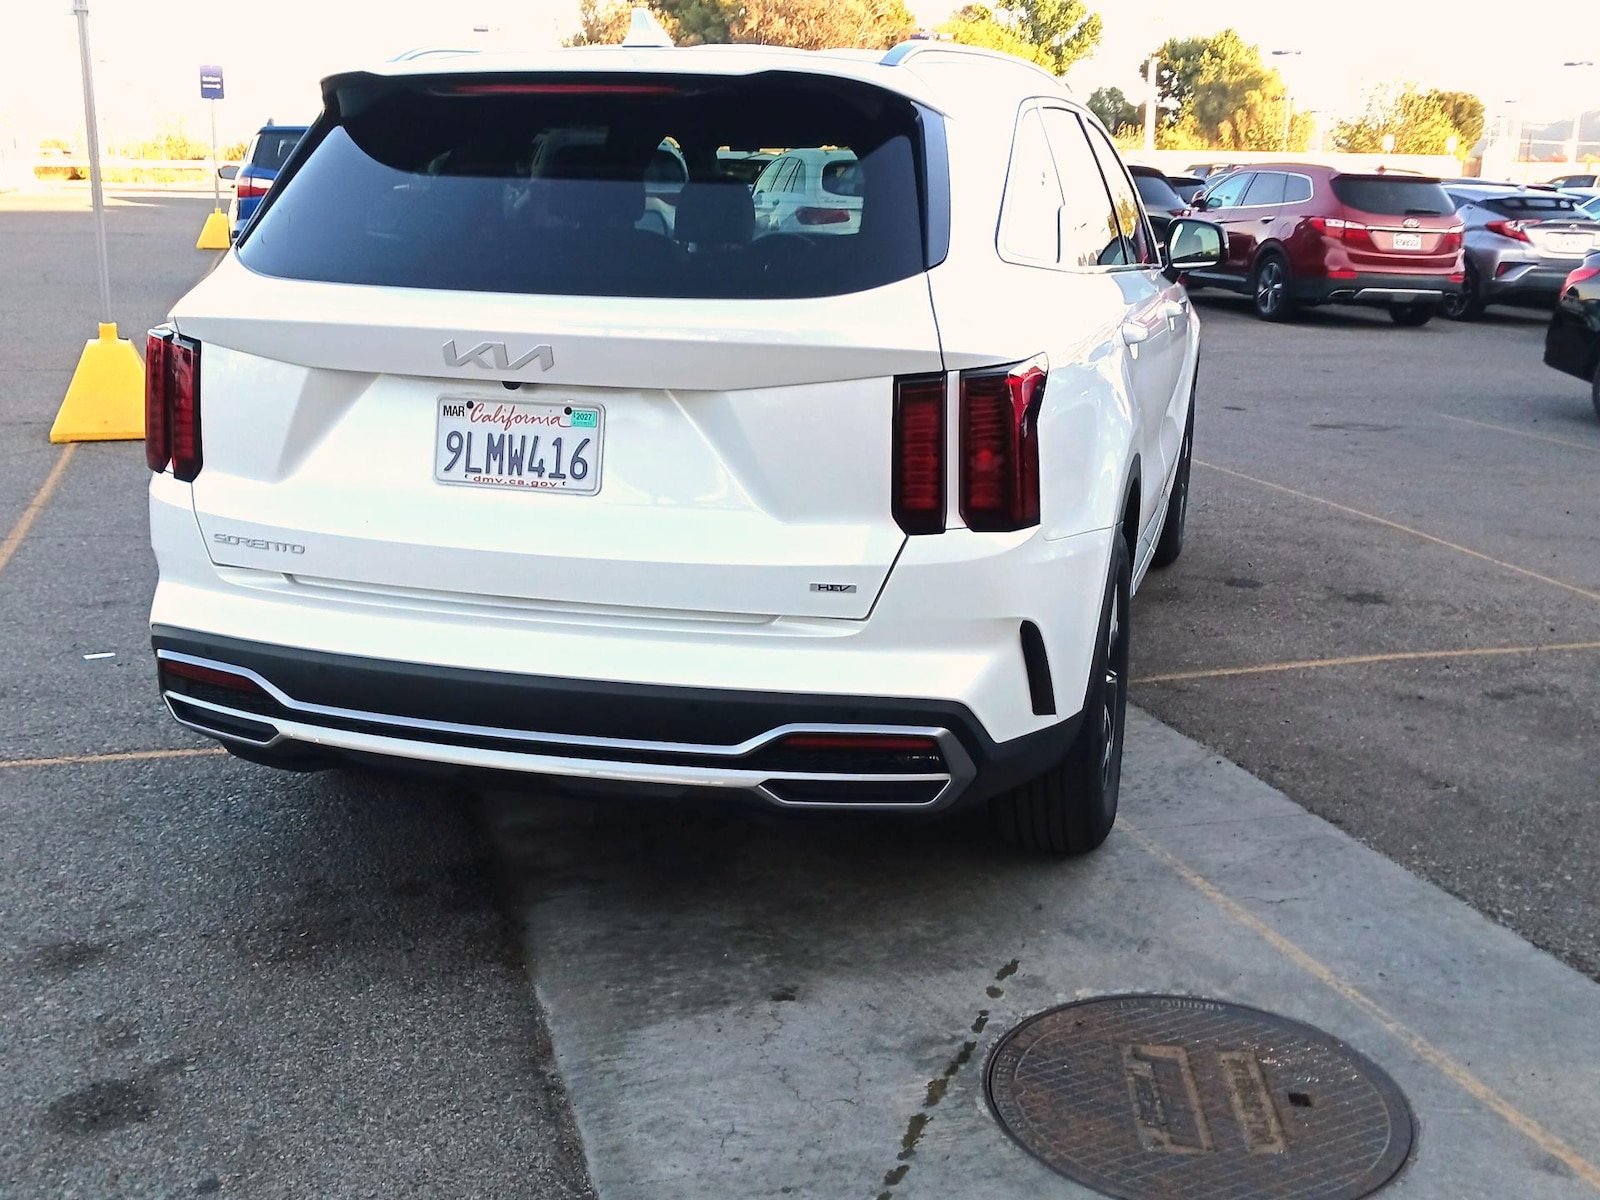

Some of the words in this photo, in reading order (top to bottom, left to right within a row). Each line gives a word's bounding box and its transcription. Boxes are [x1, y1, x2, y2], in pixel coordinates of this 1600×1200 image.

[442, 339, 555, 372] KIA
[443, 405, 466, 417] MAR
[470, 402, 573, 431] California
[576, 412, 593, 421] 2027
[444, 430, 591, 480] 9LMW416
[473, 475, 558, 488] dmv.ca.gov
[213, 533, 306, 554] SORENTO
[818, 584, 851, 592] HEV
